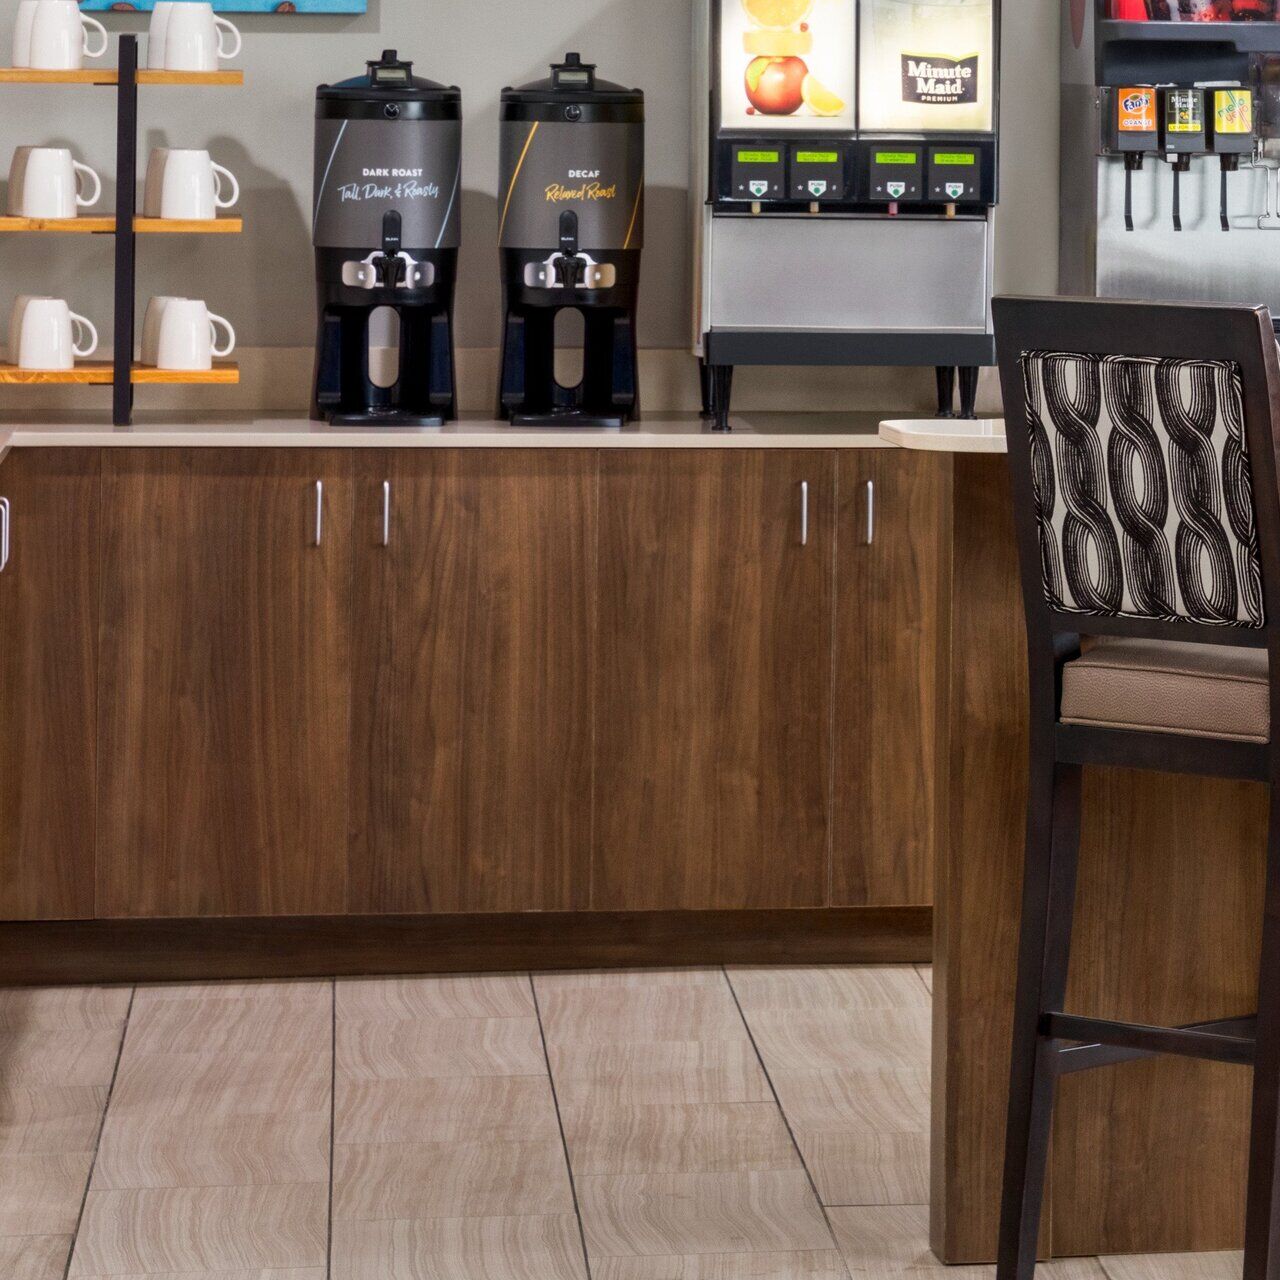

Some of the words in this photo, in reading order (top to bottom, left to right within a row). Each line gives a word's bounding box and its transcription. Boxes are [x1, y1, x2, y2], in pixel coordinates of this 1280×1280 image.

[907, 60, 972, 79] Minute
[916, 78, 962, 95] Maid
[1123, 97, 1149, 112] Fanta
[362, 168, 389, 177] DARK
[392, 168, 423, 177] ROAST
[568, 170, 600, 178] DECAF
[403, 180, 439, 199] Roasty
[545, 183, 585, 203] Relaxed
[585, 182, 616, 200] Roast
